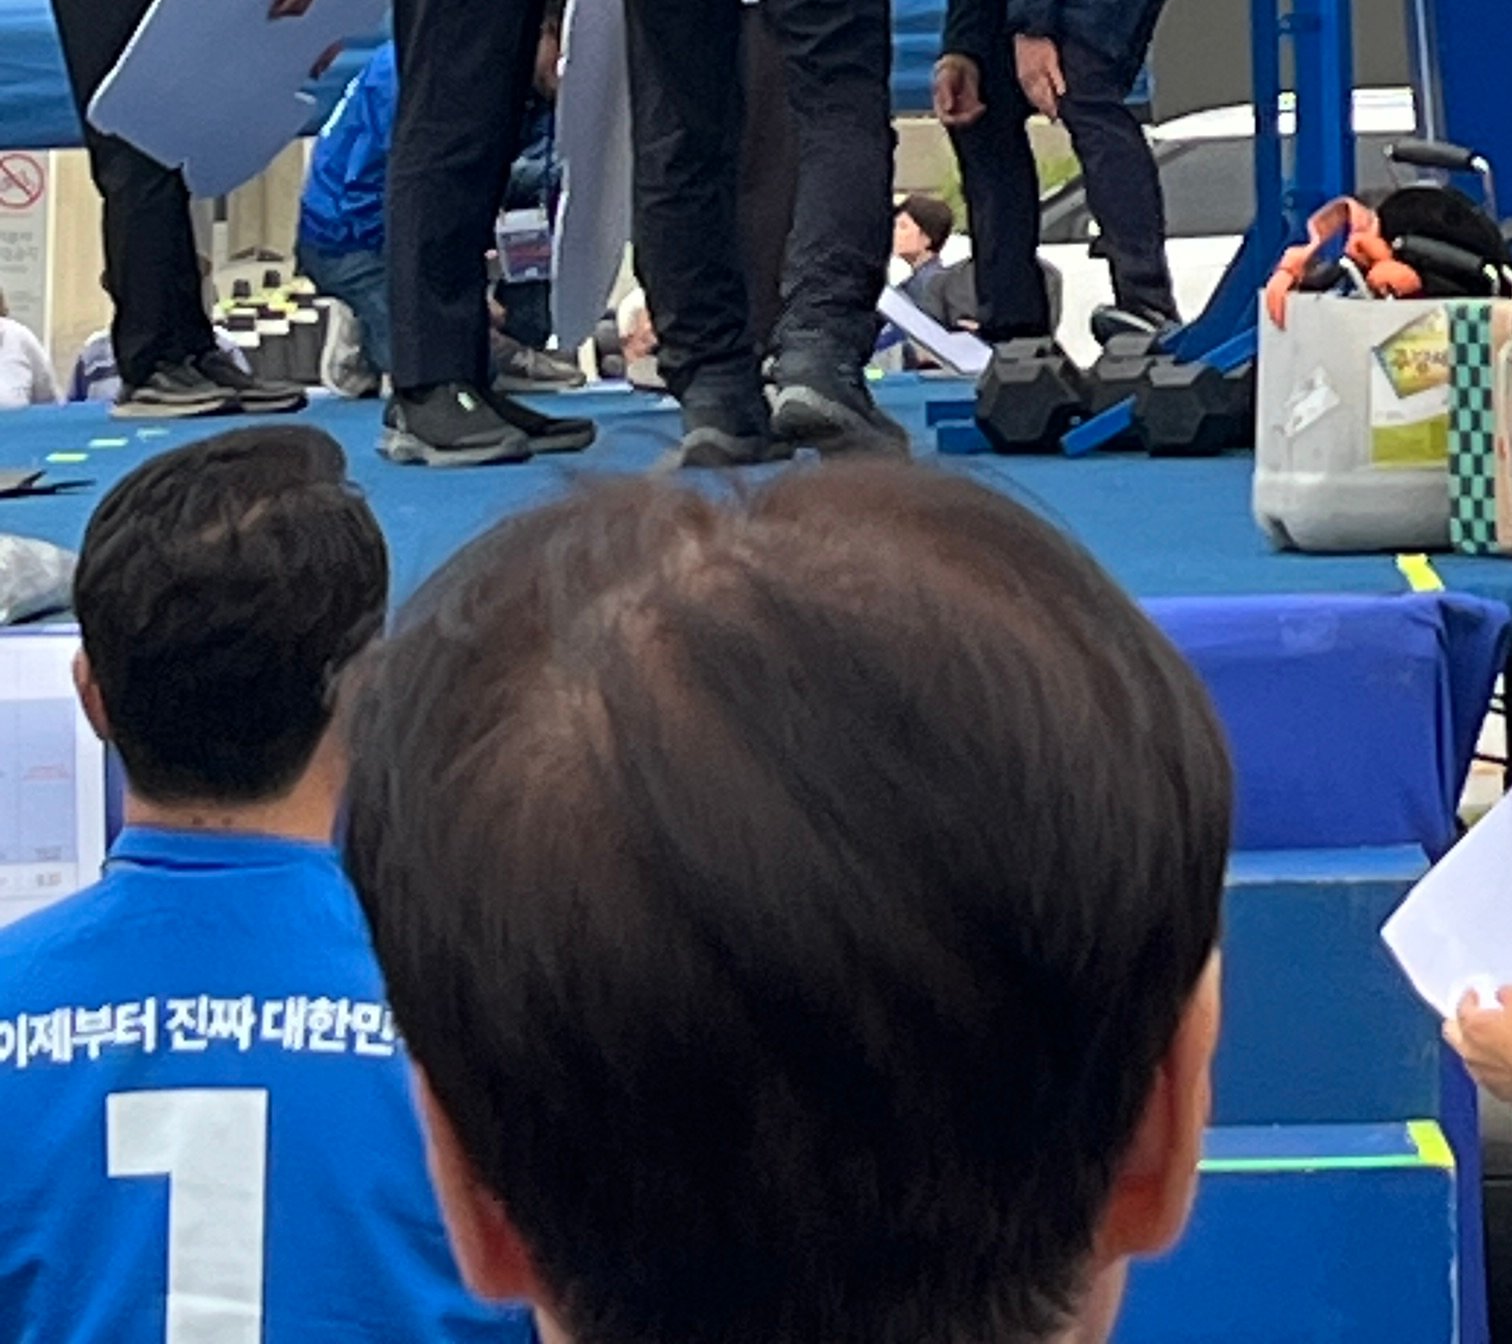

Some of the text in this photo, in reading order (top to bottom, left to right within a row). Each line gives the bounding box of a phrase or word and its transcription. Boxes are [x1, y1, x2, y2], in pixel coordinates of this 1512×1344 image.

[0, 994, 402, 1069] 이제부터 진짜 대한민
[106, 1088, 269, 1344] 1
